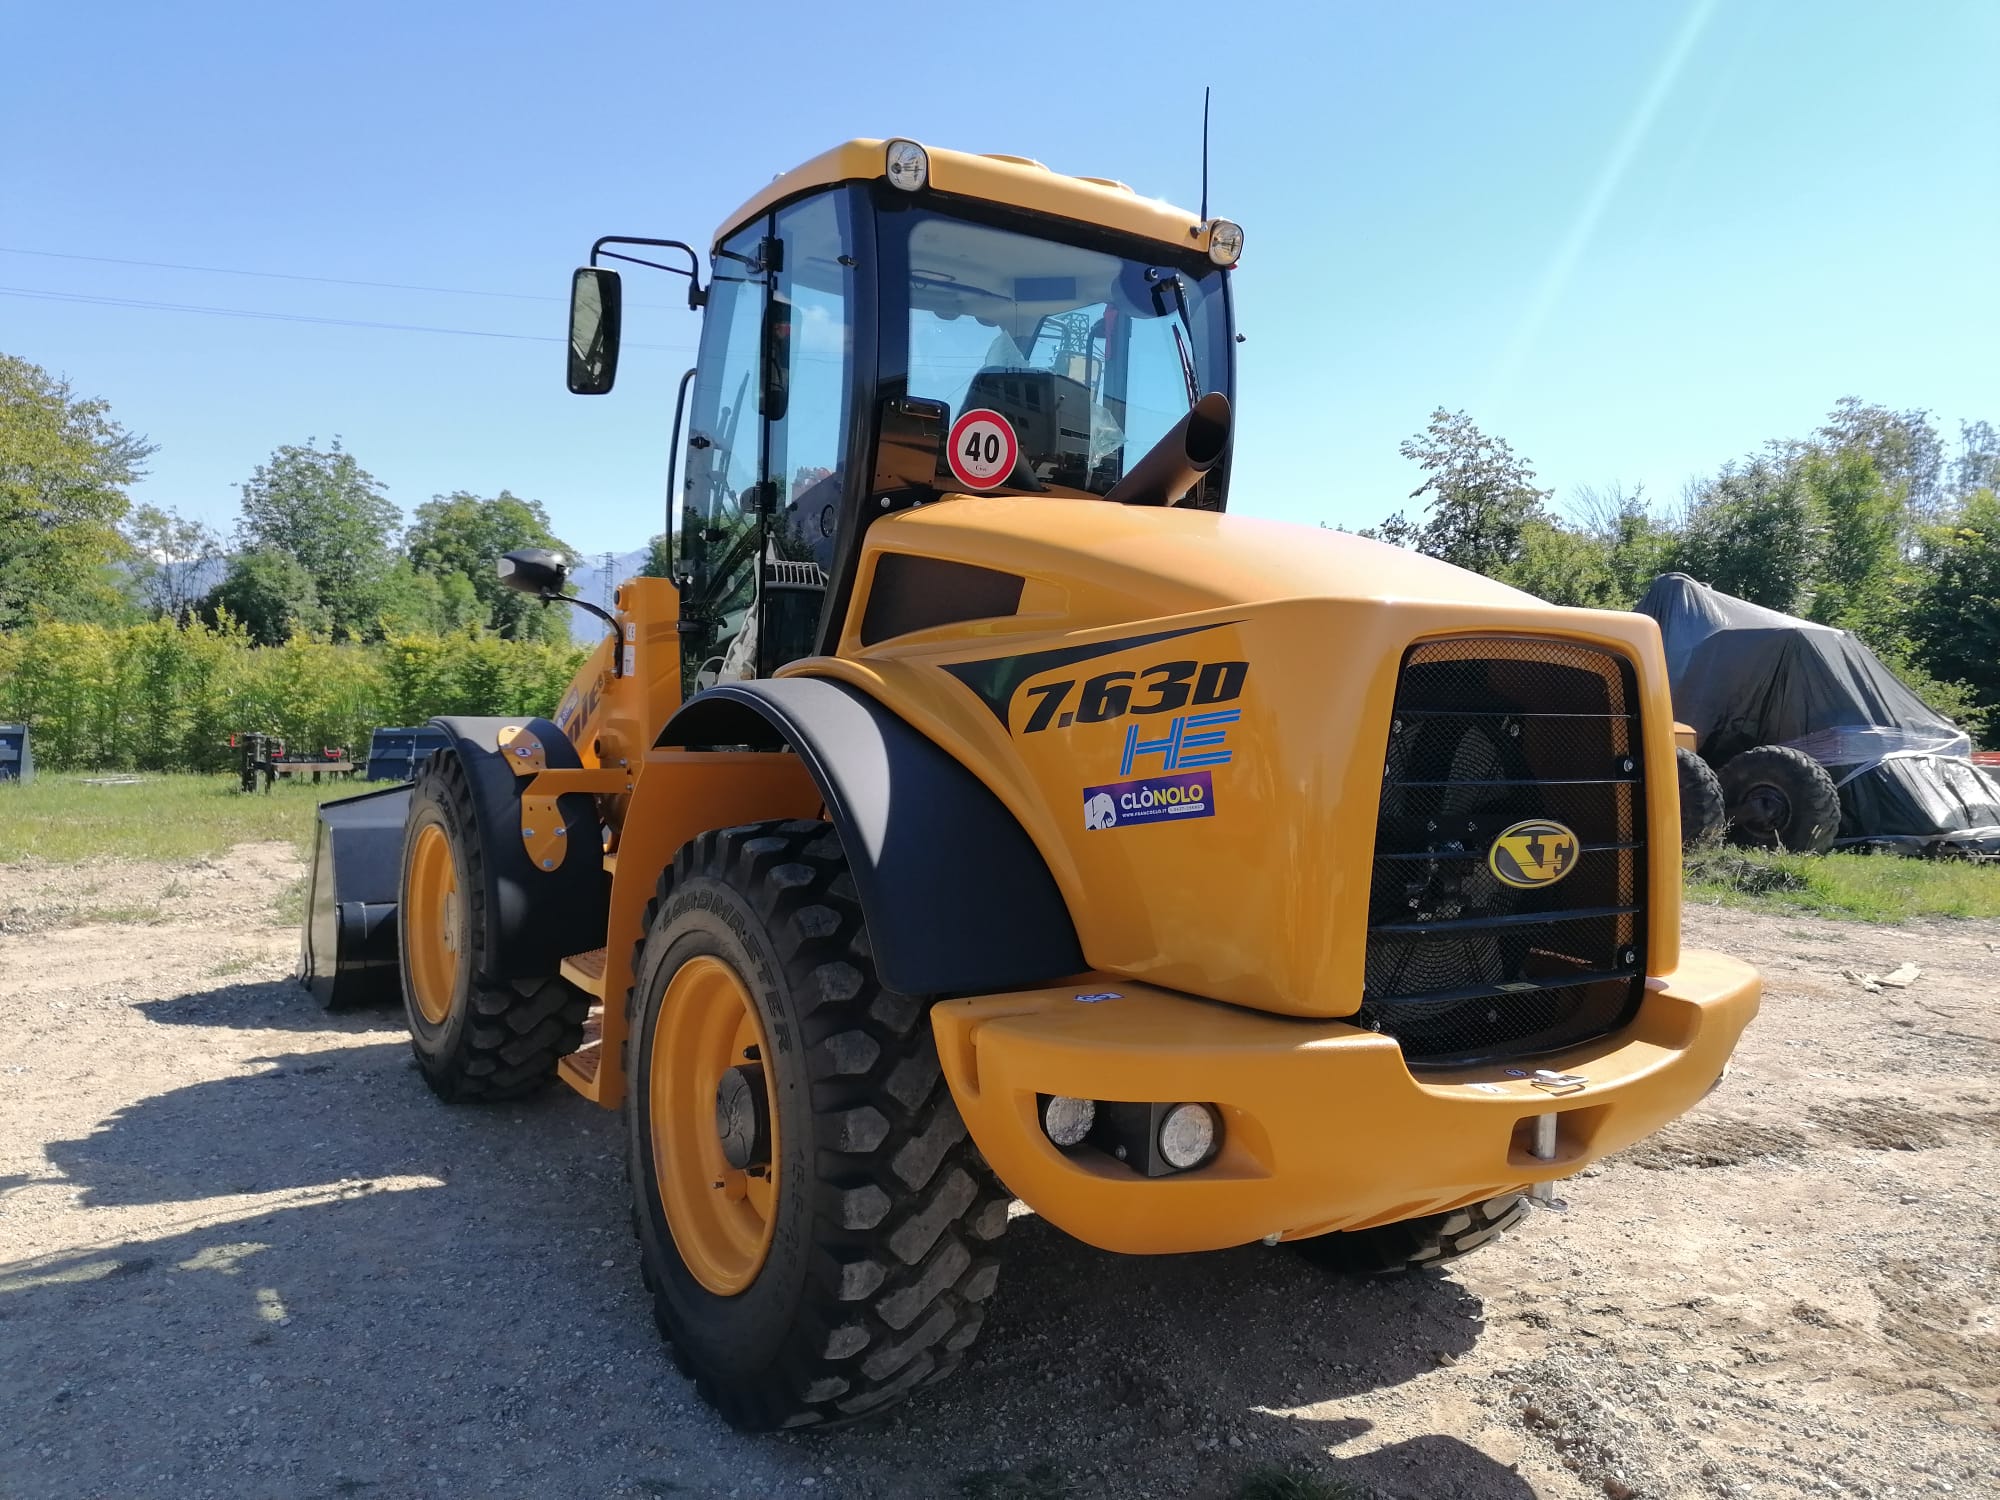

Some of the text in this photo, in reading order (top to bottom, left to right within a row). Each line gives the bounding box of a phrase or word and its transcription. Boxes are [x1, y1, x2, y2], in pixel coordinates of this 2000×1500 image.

[965, 431, 1000, 464] 40
[1023, 660, 1250, 734] 7.630
[1119, 708, 1242, 777] HE
[1120, 784, 1204, 810] CLÒNOLO
[663, 889, 792, 1054] LOADMASTER
